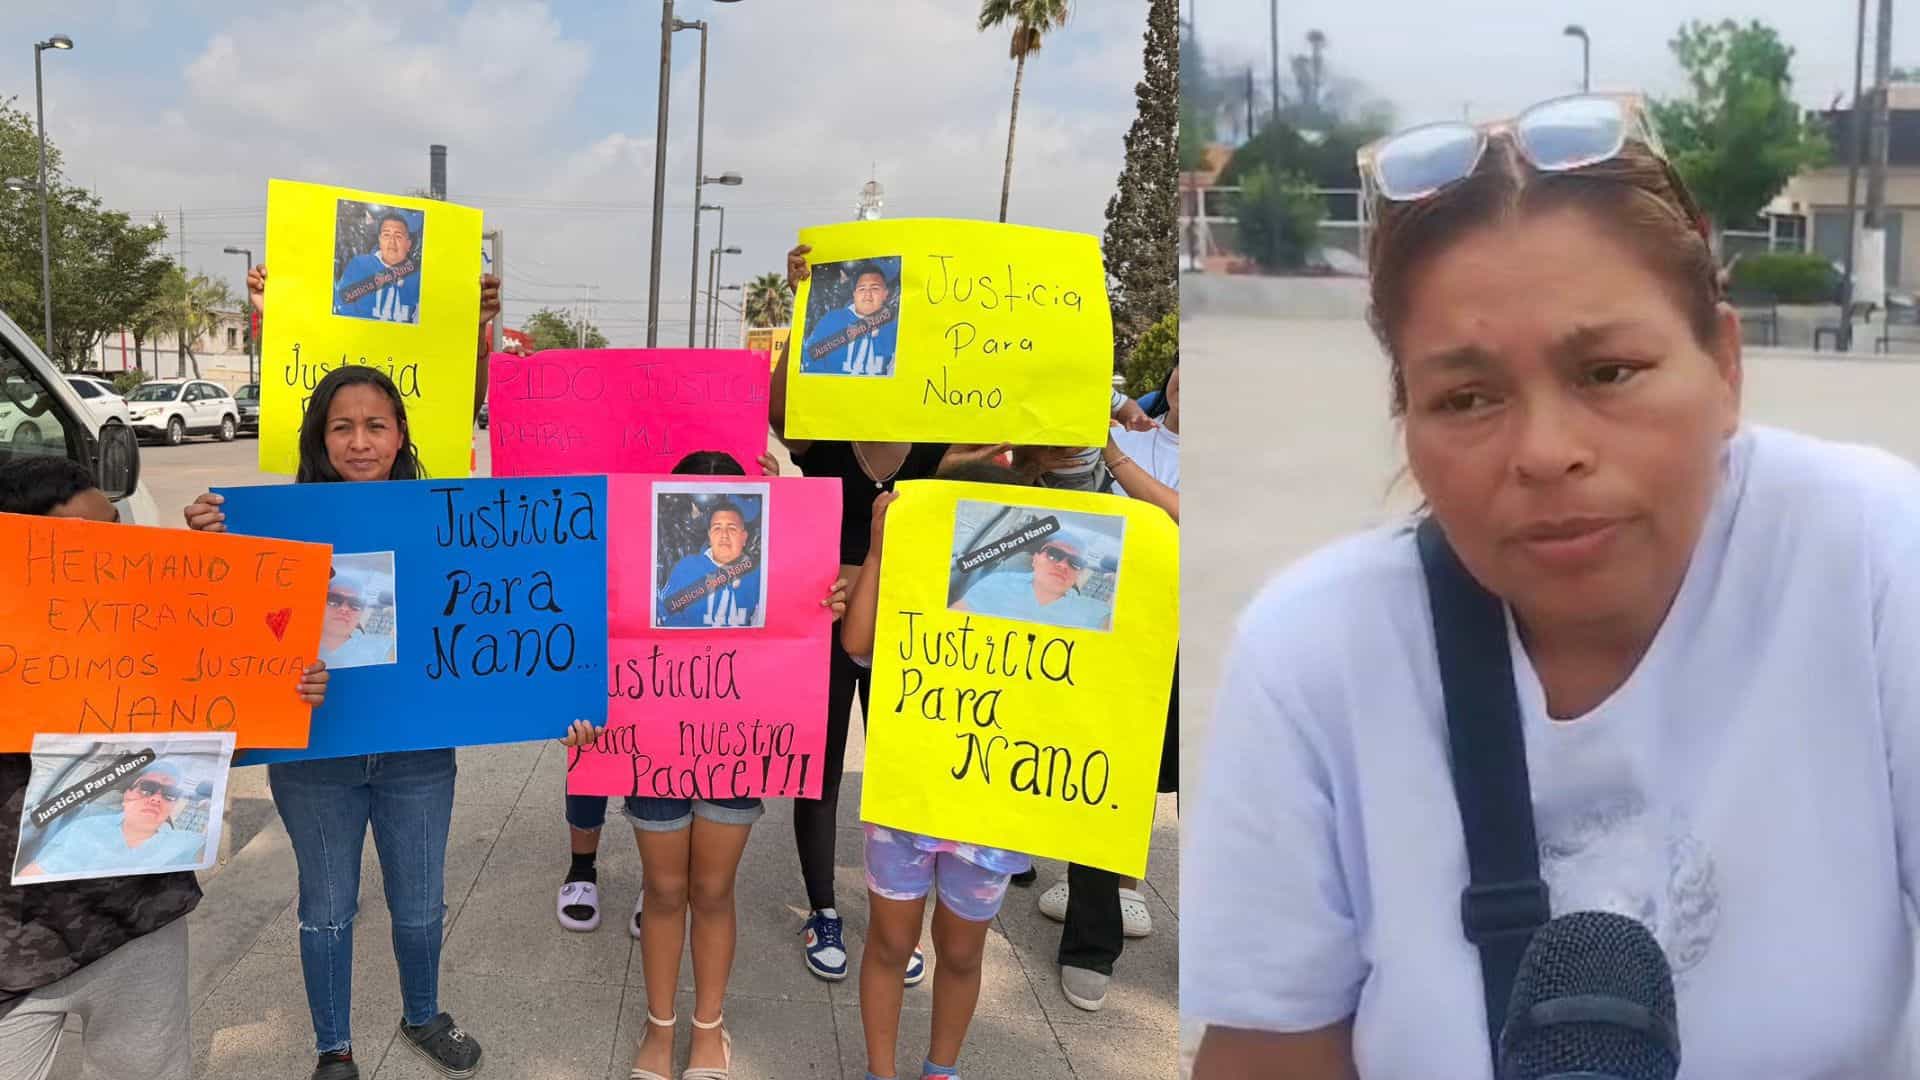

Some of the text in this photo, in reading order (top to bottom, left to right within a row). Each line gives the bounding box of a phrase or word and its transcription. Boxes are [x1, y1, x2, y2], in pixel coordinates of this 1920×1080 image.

[925, 254, 1083, 313] Justicia
[944, 321, 1034, 358] Para
[923, 366, 1002, 409] Nano
[430, 487, 598, 549] Justicia
[26, 527, 301, 588] HERMANO TE
[962, 522, 1053, 571] Justicia Para Nano
[443, 569, 564, 616] Para
[182, 648, 304, 683] JUSTICIA
[898, 611, 1077, 686] Justicia
[78, 687, 237, 734] NANO
[894, 667, 1002, 729] Para
[679, 718, 795, 758] nuestro
[38, 755, 148, 822] Justicia Para Nano
[631, 753, 811, 800] Padre!!!
[951, 732, 1119, 810] Nano.
